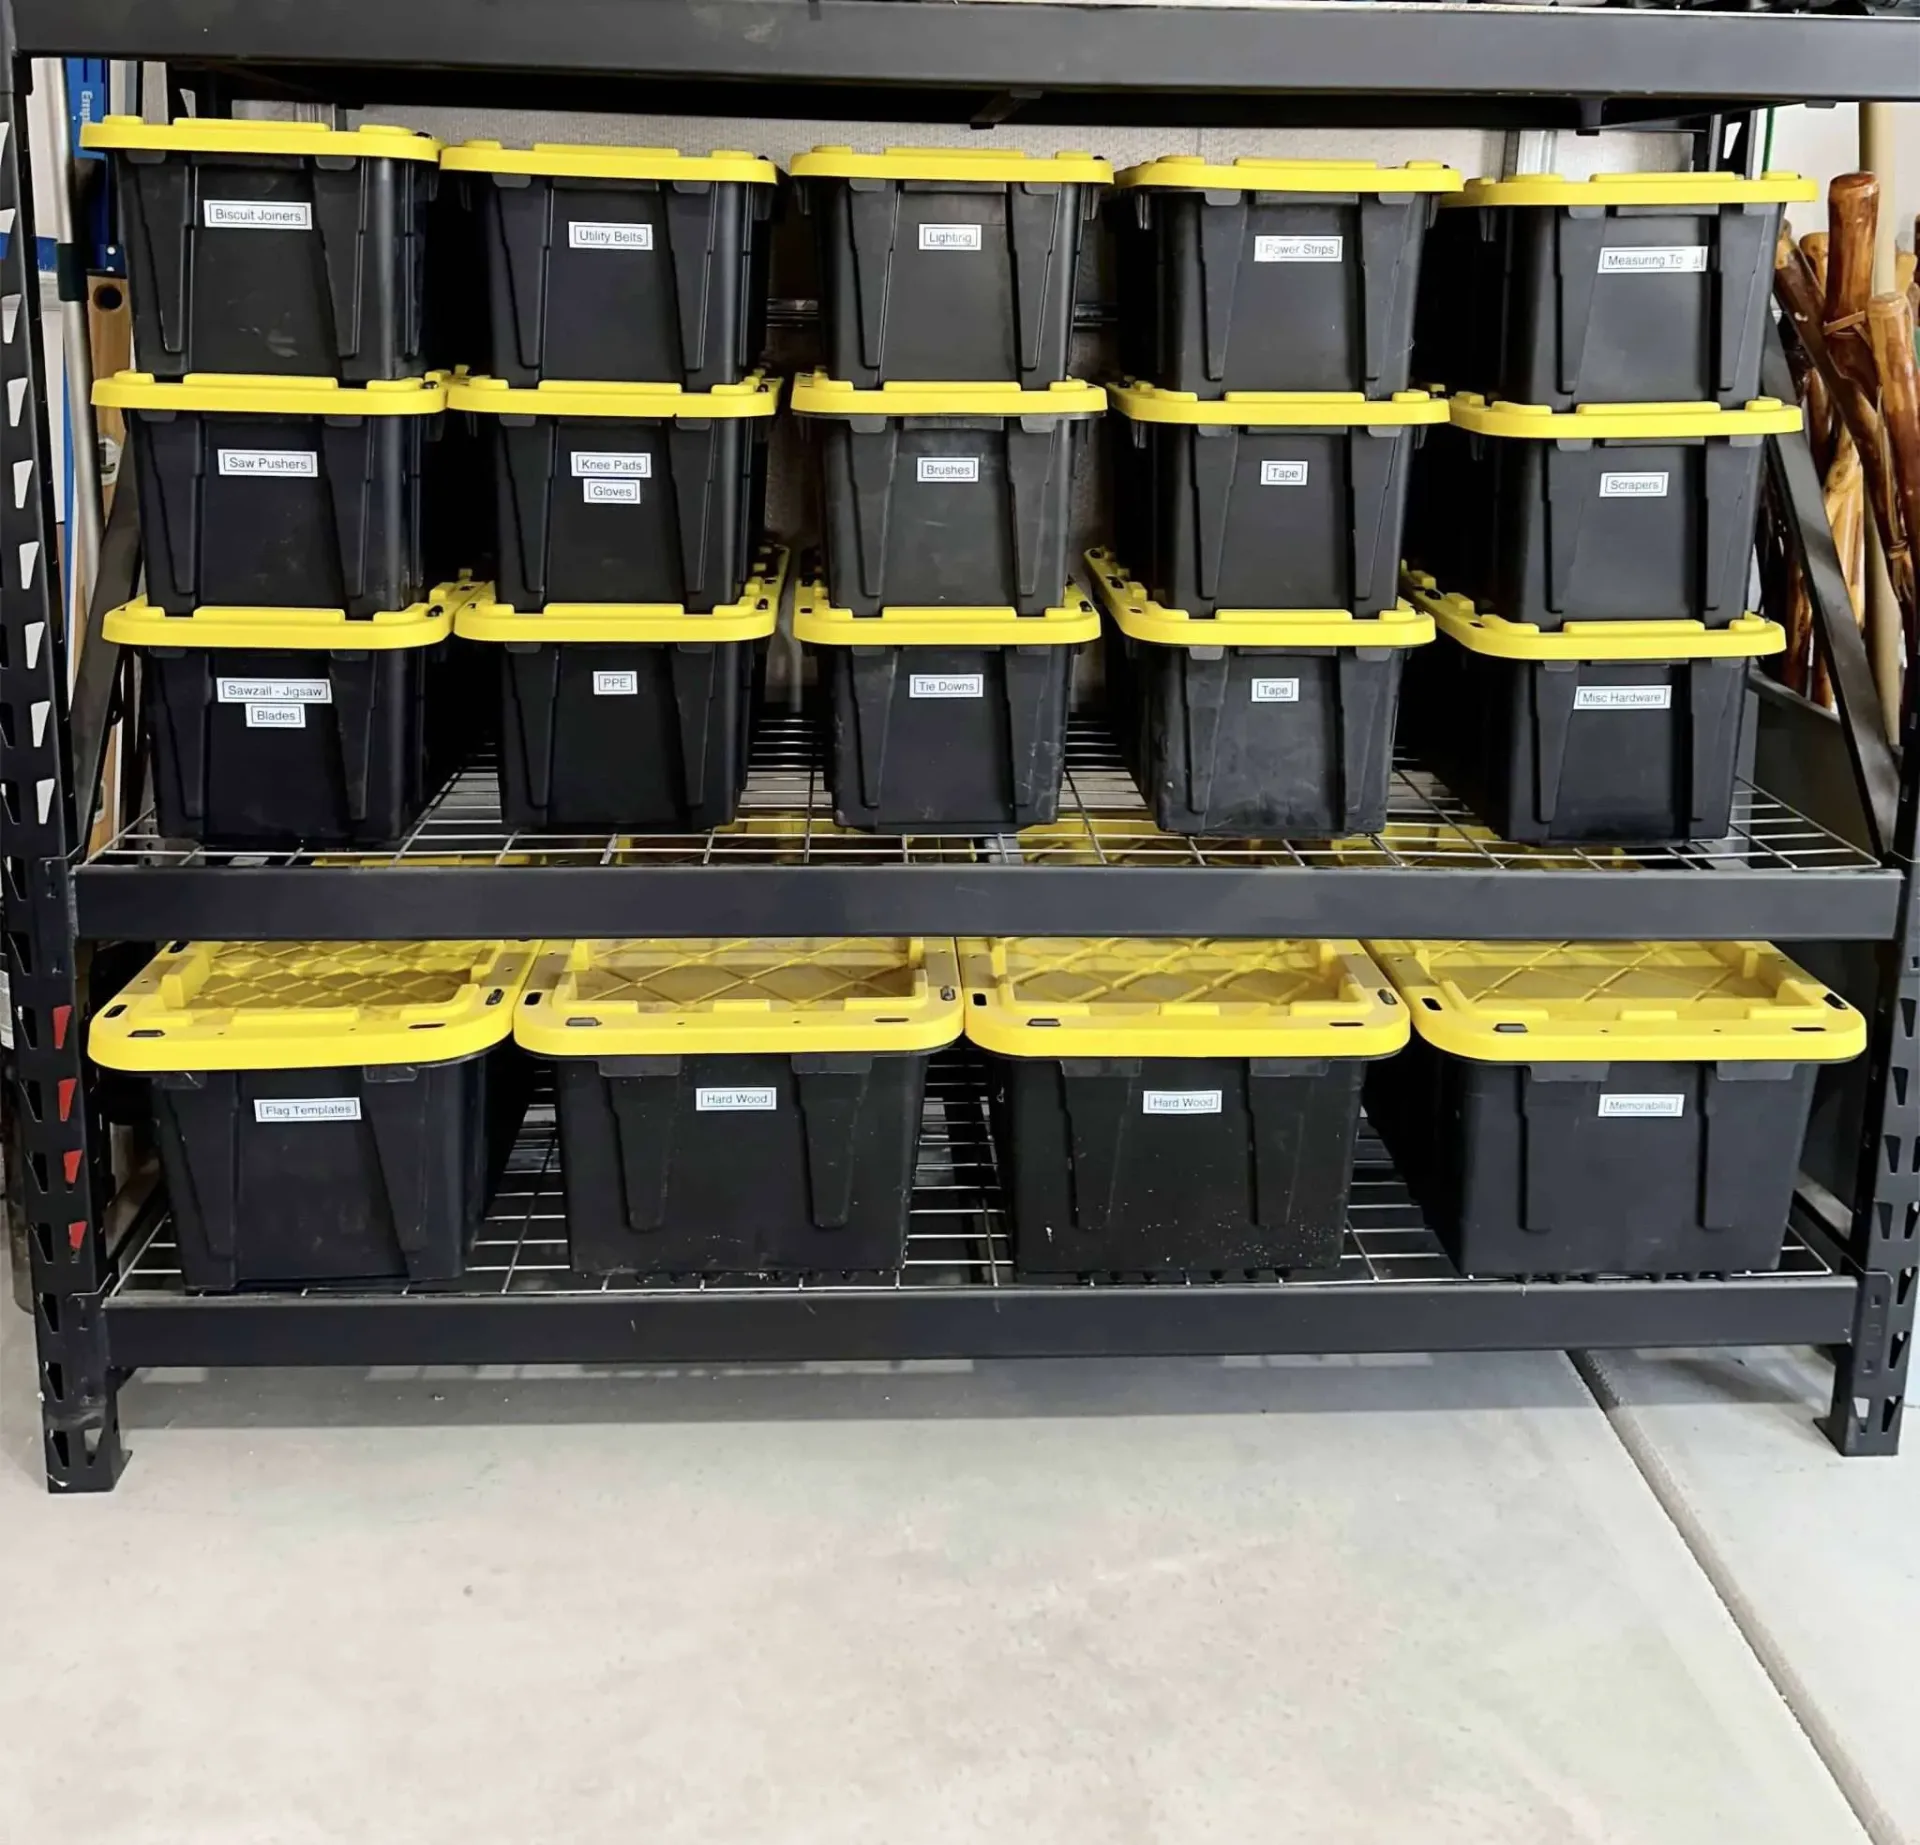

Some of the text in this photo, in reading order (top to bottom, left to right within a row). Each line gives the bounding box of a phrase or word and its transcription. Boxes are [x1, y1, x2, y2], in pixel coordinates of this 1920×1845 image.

[216, 209, 301, 222] Biscuit Joiners
[579, 230, 643, 244] Utility Belts
[929, 232, 972, 245] Lighting
[1265, 244, 1334, 256] Power Strips
[1608, 255, 1665, 265] Measuring
[229, 457, 307, 469] Saw Pushers
[582, 460, 642, 470] Knee Pads
[926, 465, 970, 475] Brushes
[1272, 468, 1298, 479] Tape
[1611, 480, 1659, 490] Scrapers
[593, 486, 632, 496] Gloves
[604, 678, 627, 688] PPE
[919, 682, 974, 691] Tie Downs
[228, 685, 272, 696] Sawzall
[283, 686, 322, 698] Jigsaw
[1262, 686, 1288, 696] Tape
[1583, 693, 1661, 702] Misc Hardware
[257, 711, 295, 720] Blades
[707, 1094, 767, 1104] Hard Wood
[1154, 1098, 1213, 1108] Hard Wood
[266, 1105, 351, 1116] Flag Templates
[1609, 1101, 1672, 1110] Memorabilia
